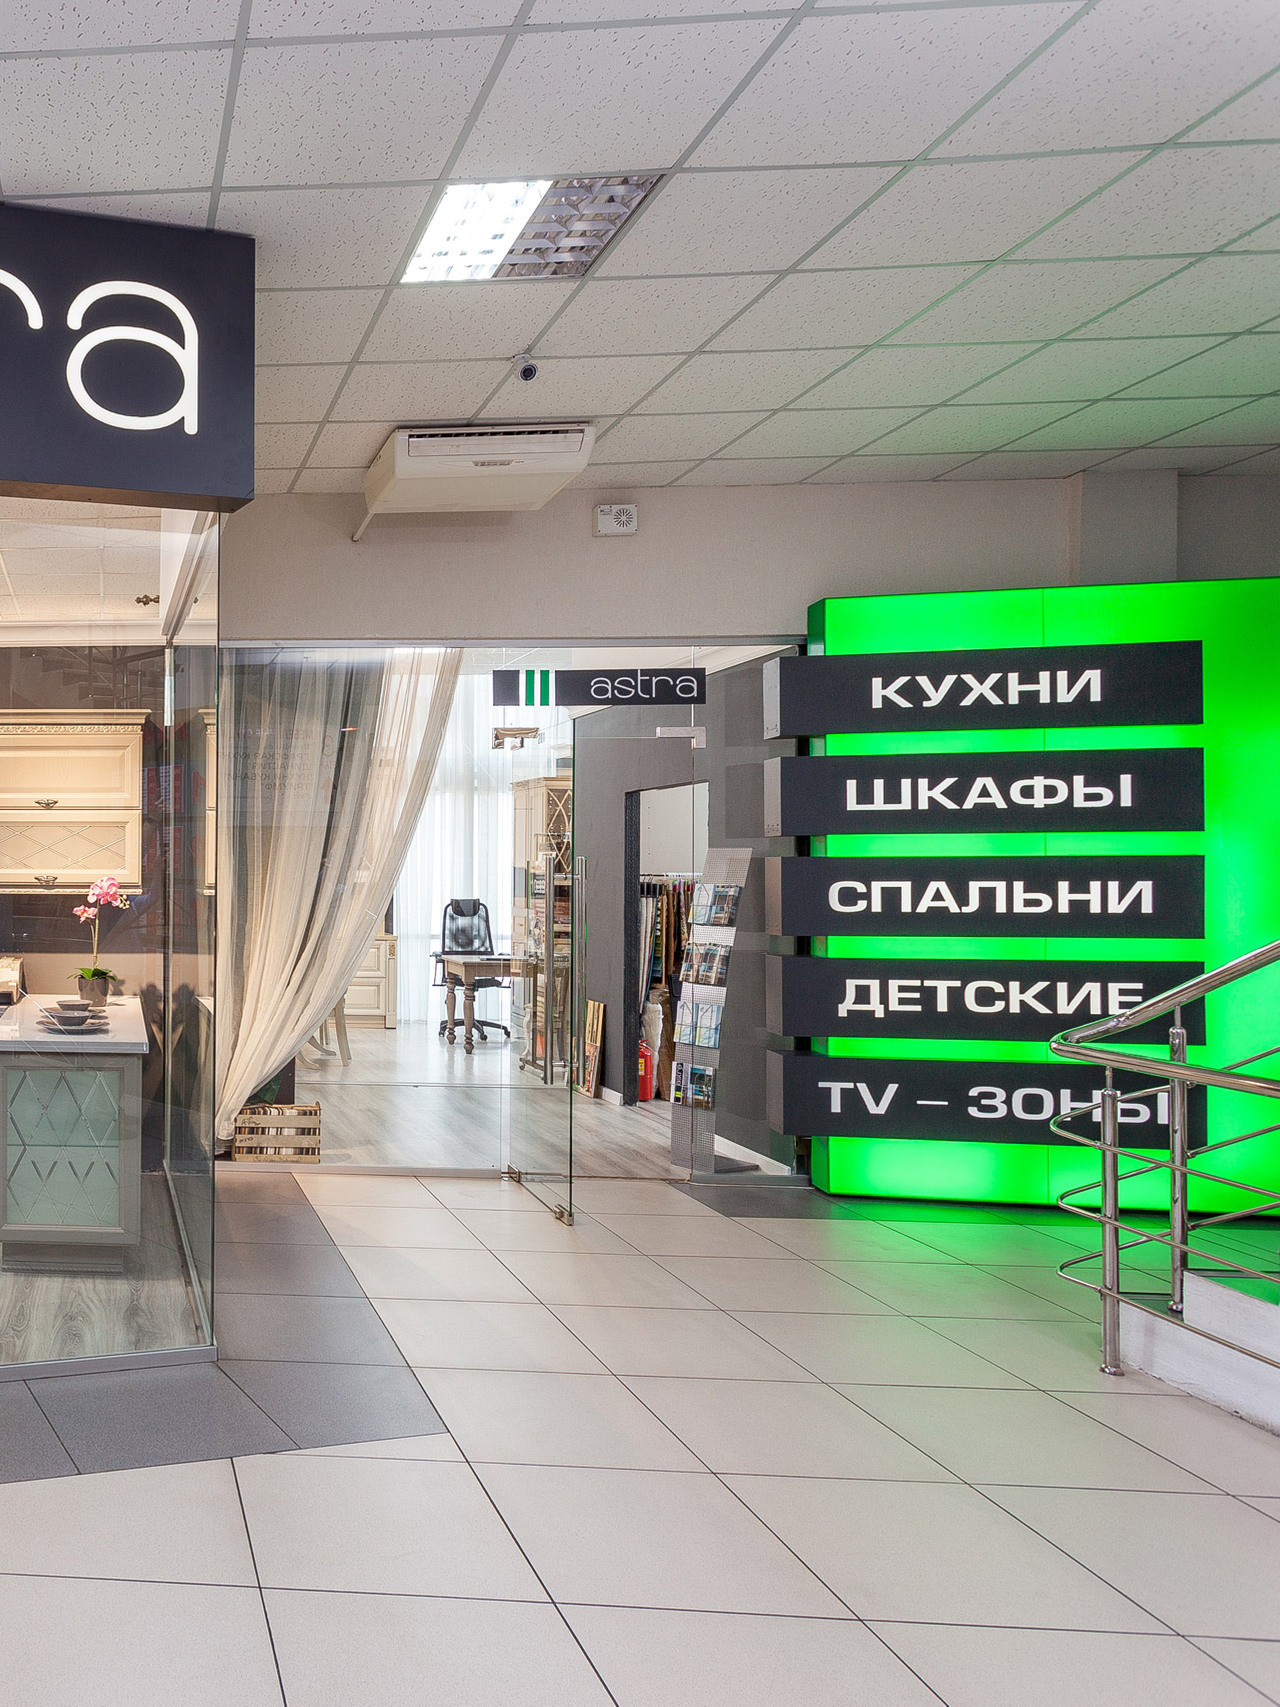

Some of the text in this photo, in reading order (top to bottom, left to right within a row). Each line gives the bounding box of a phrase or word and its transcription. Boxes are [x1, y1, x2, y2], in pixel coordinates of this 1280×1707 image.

[589, 668, 699, 699] astra
[871, 669, 1101, 709] КУХНИ
[846, 774, 1132, 811] ШКАФЫ
[827, 879, 1153, 914] СПАЛЬНИ
[838, 978, 1144, 1018] ДЕТСКИЕ
[818, 1081, 899, 1115] TV
[967, 1085, 1170, 1125] ЗОНЫ
